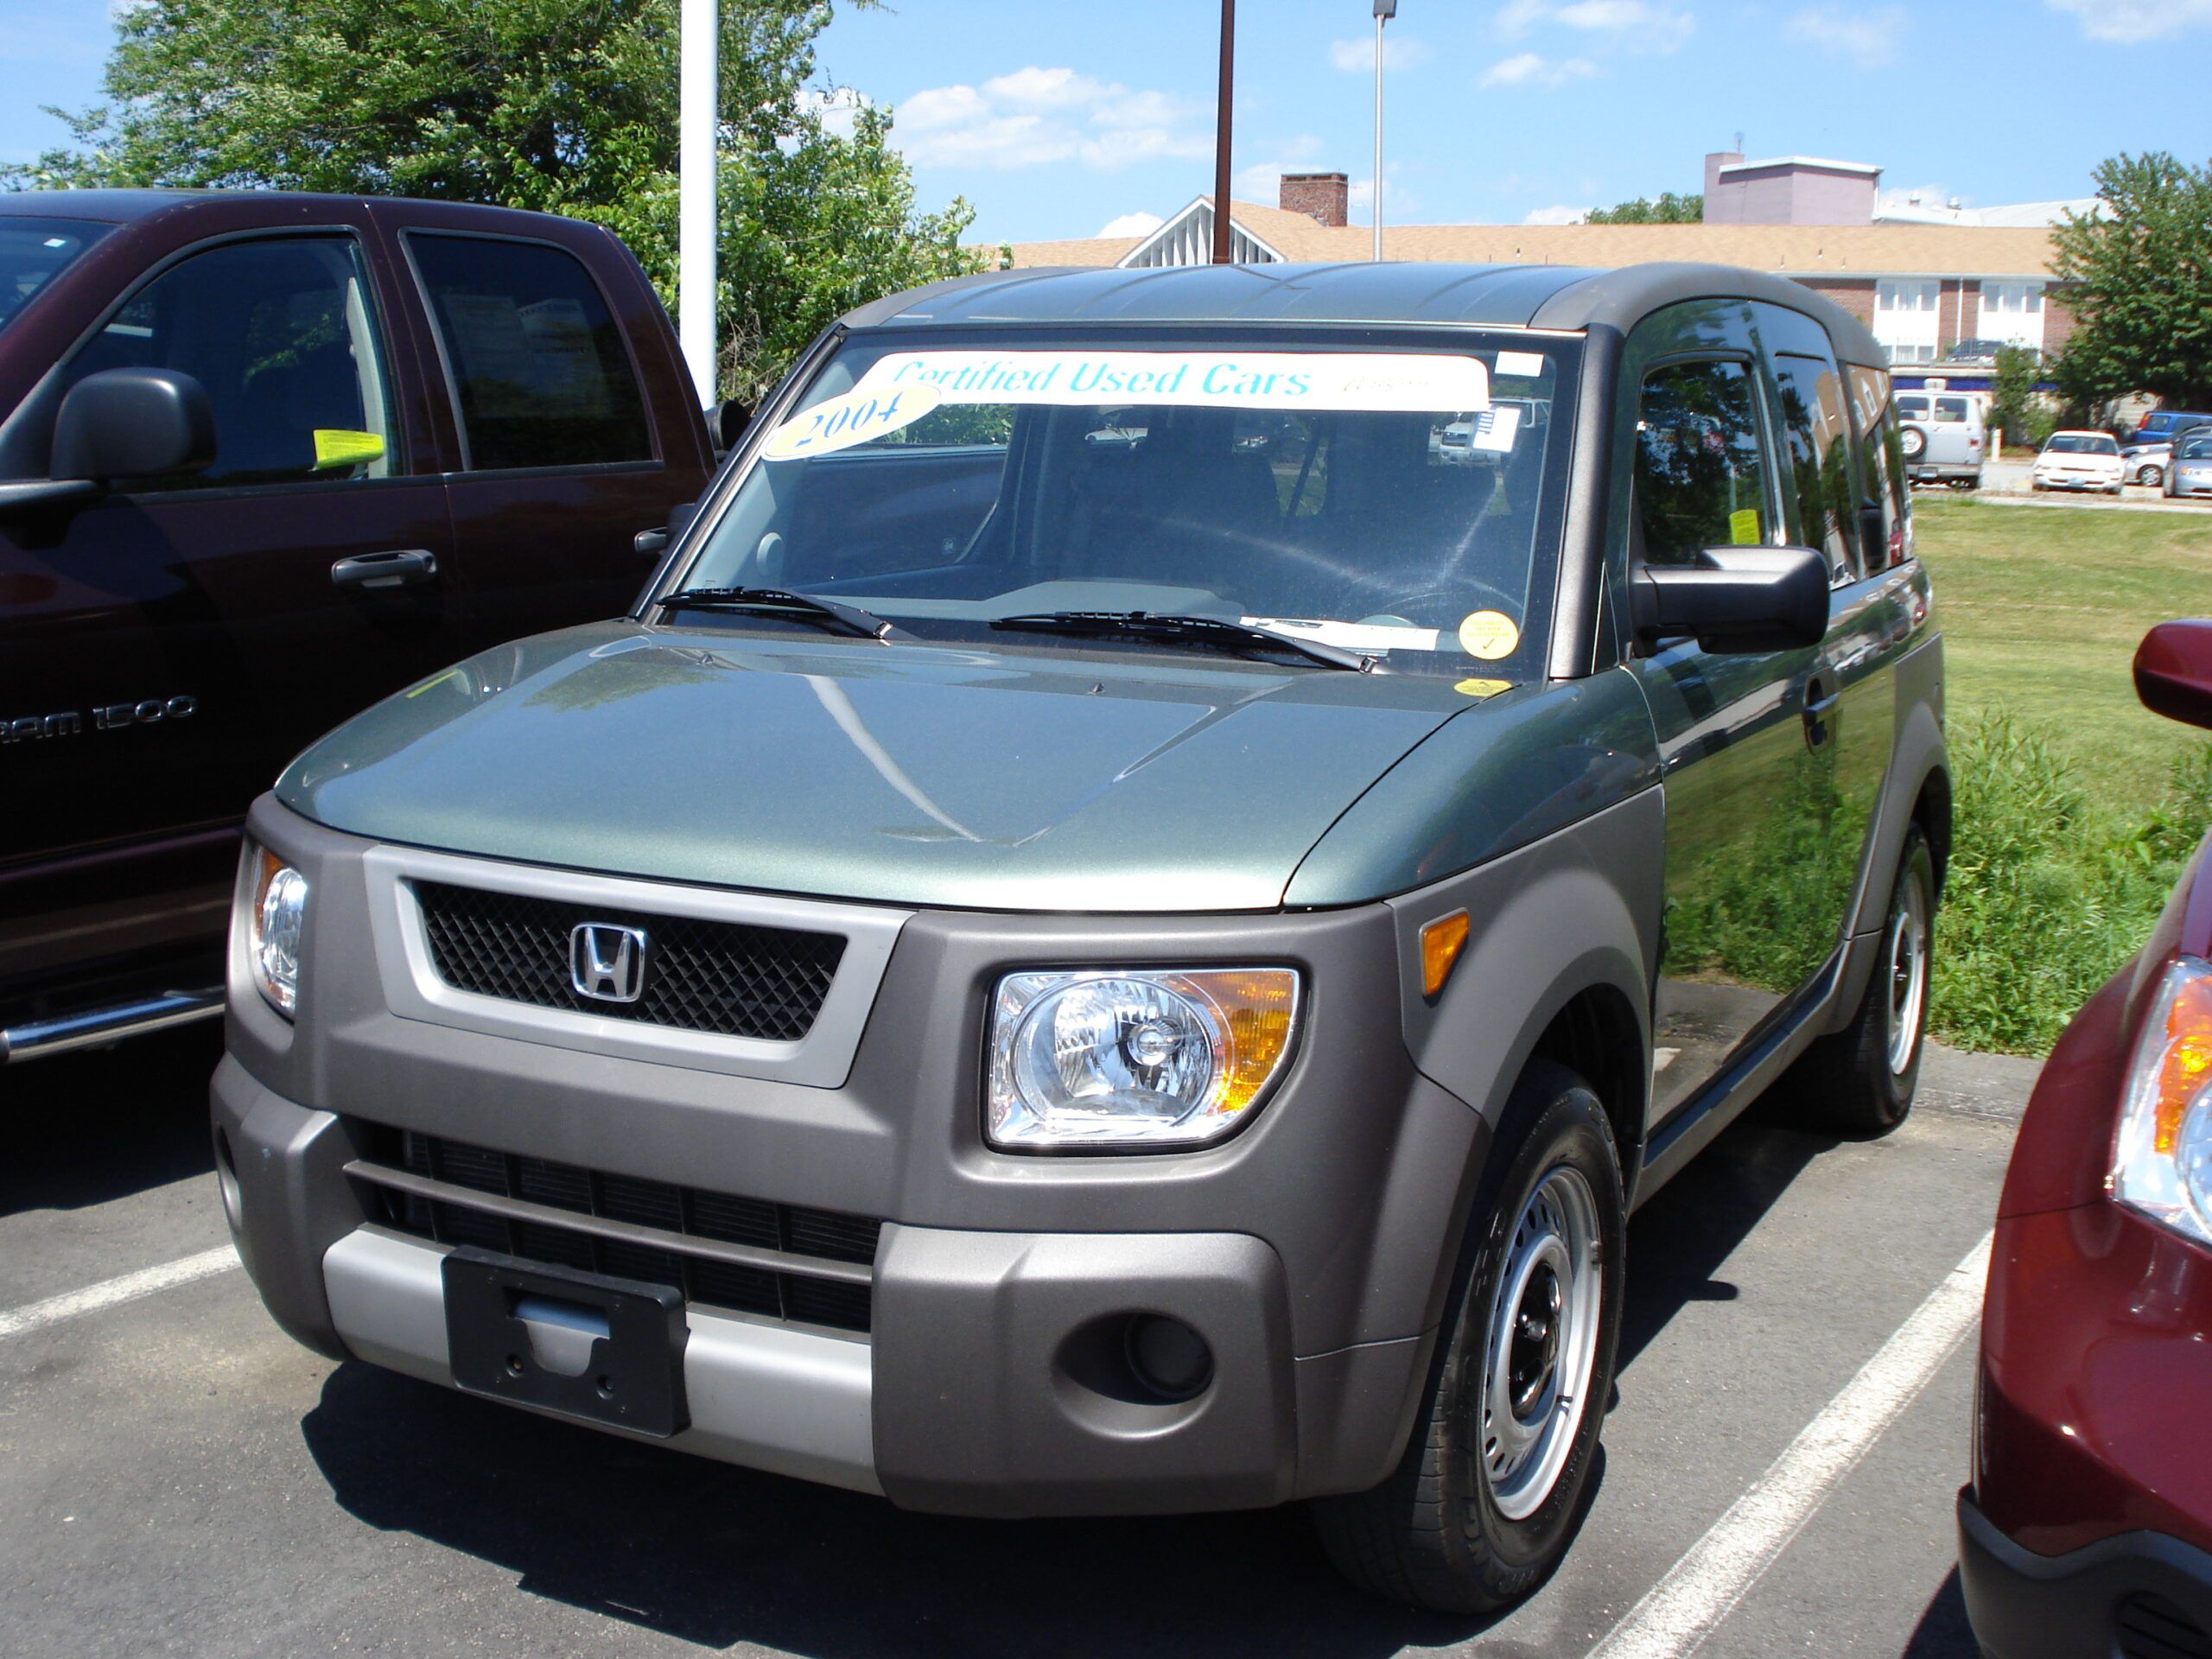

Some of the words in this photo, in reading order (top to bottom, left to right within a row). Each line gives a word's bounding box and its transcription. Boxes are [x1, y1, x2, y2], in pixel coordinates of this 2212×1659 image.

[893, 360, 1062, 391] Certified
[1070, 362, 1189, 392] Used
[1202, 363, 1312, 396] Cars
[795, 391, 903, 447] 2004
[92, 695, 196, 731] 1500
